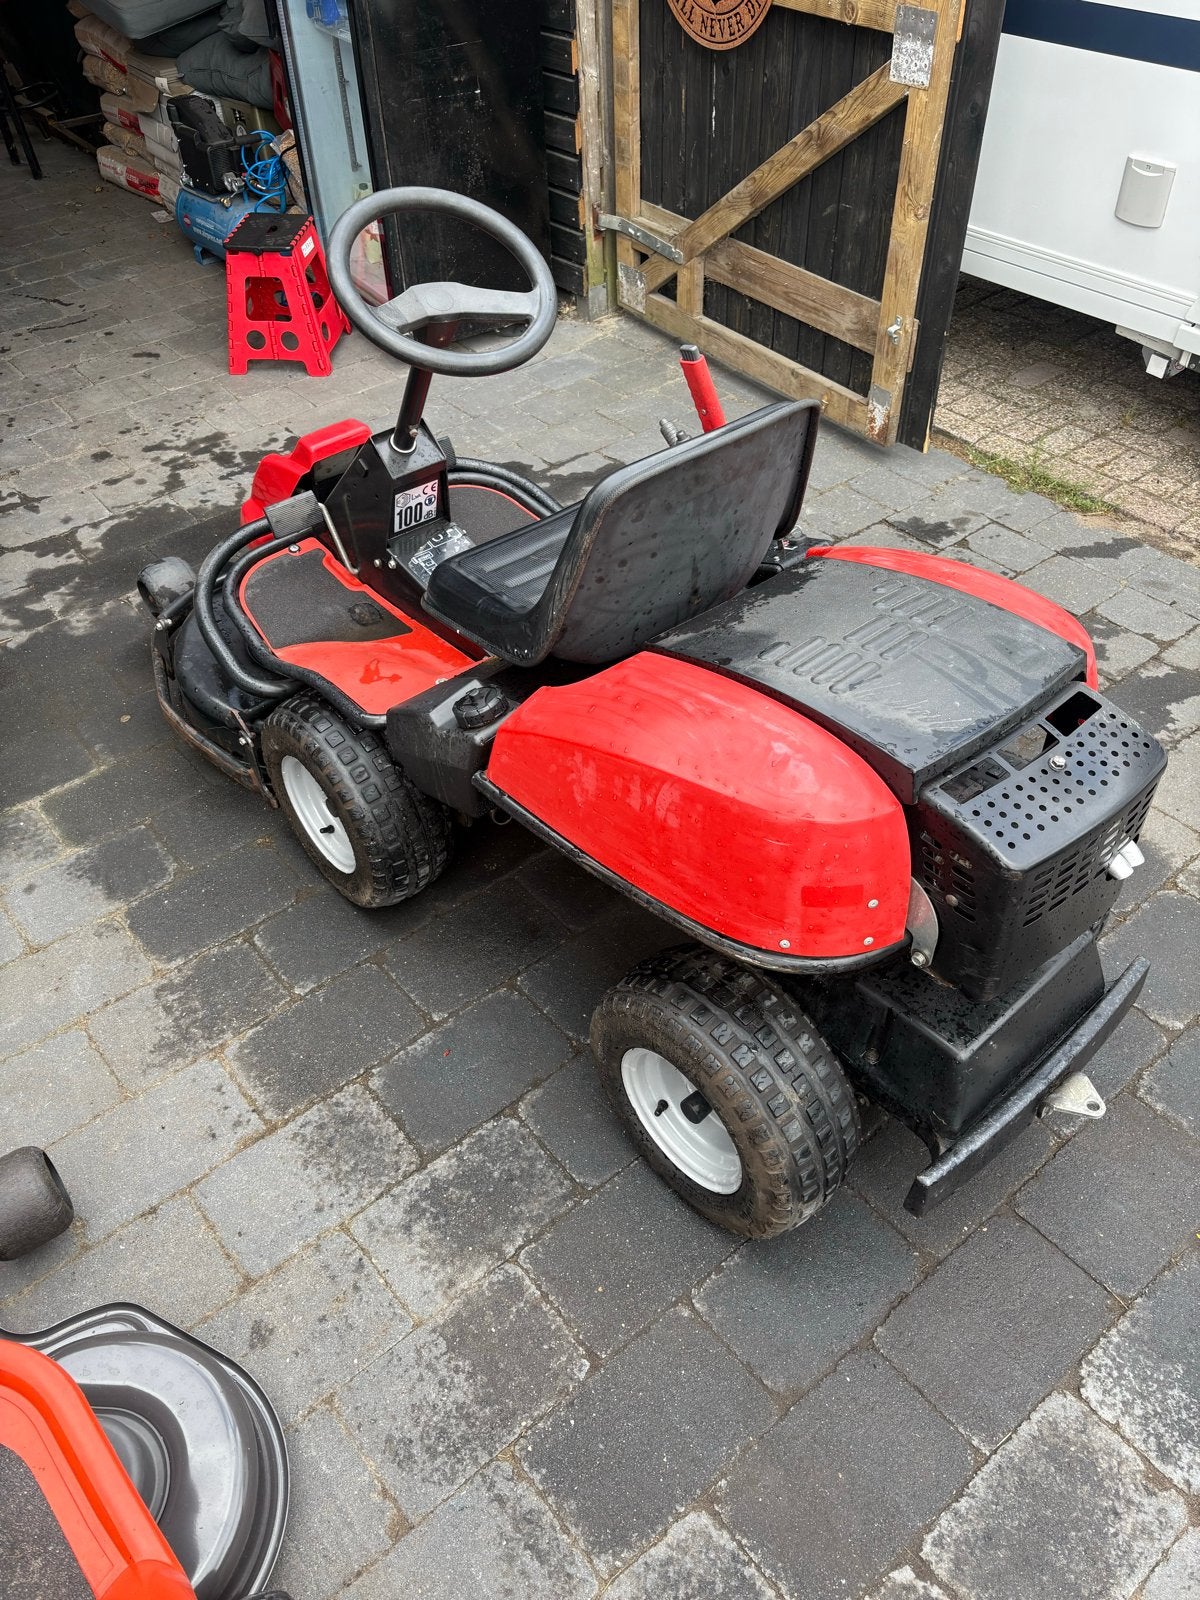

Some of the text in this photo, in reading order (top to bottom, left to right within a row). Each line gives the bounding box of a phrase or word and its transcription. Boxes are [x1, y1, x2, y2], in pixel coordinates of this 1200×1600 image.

[676, 0, 694, 24] LL
[699, 11, 745, 38] NEVER
[396, 502, 423, 530] 100
